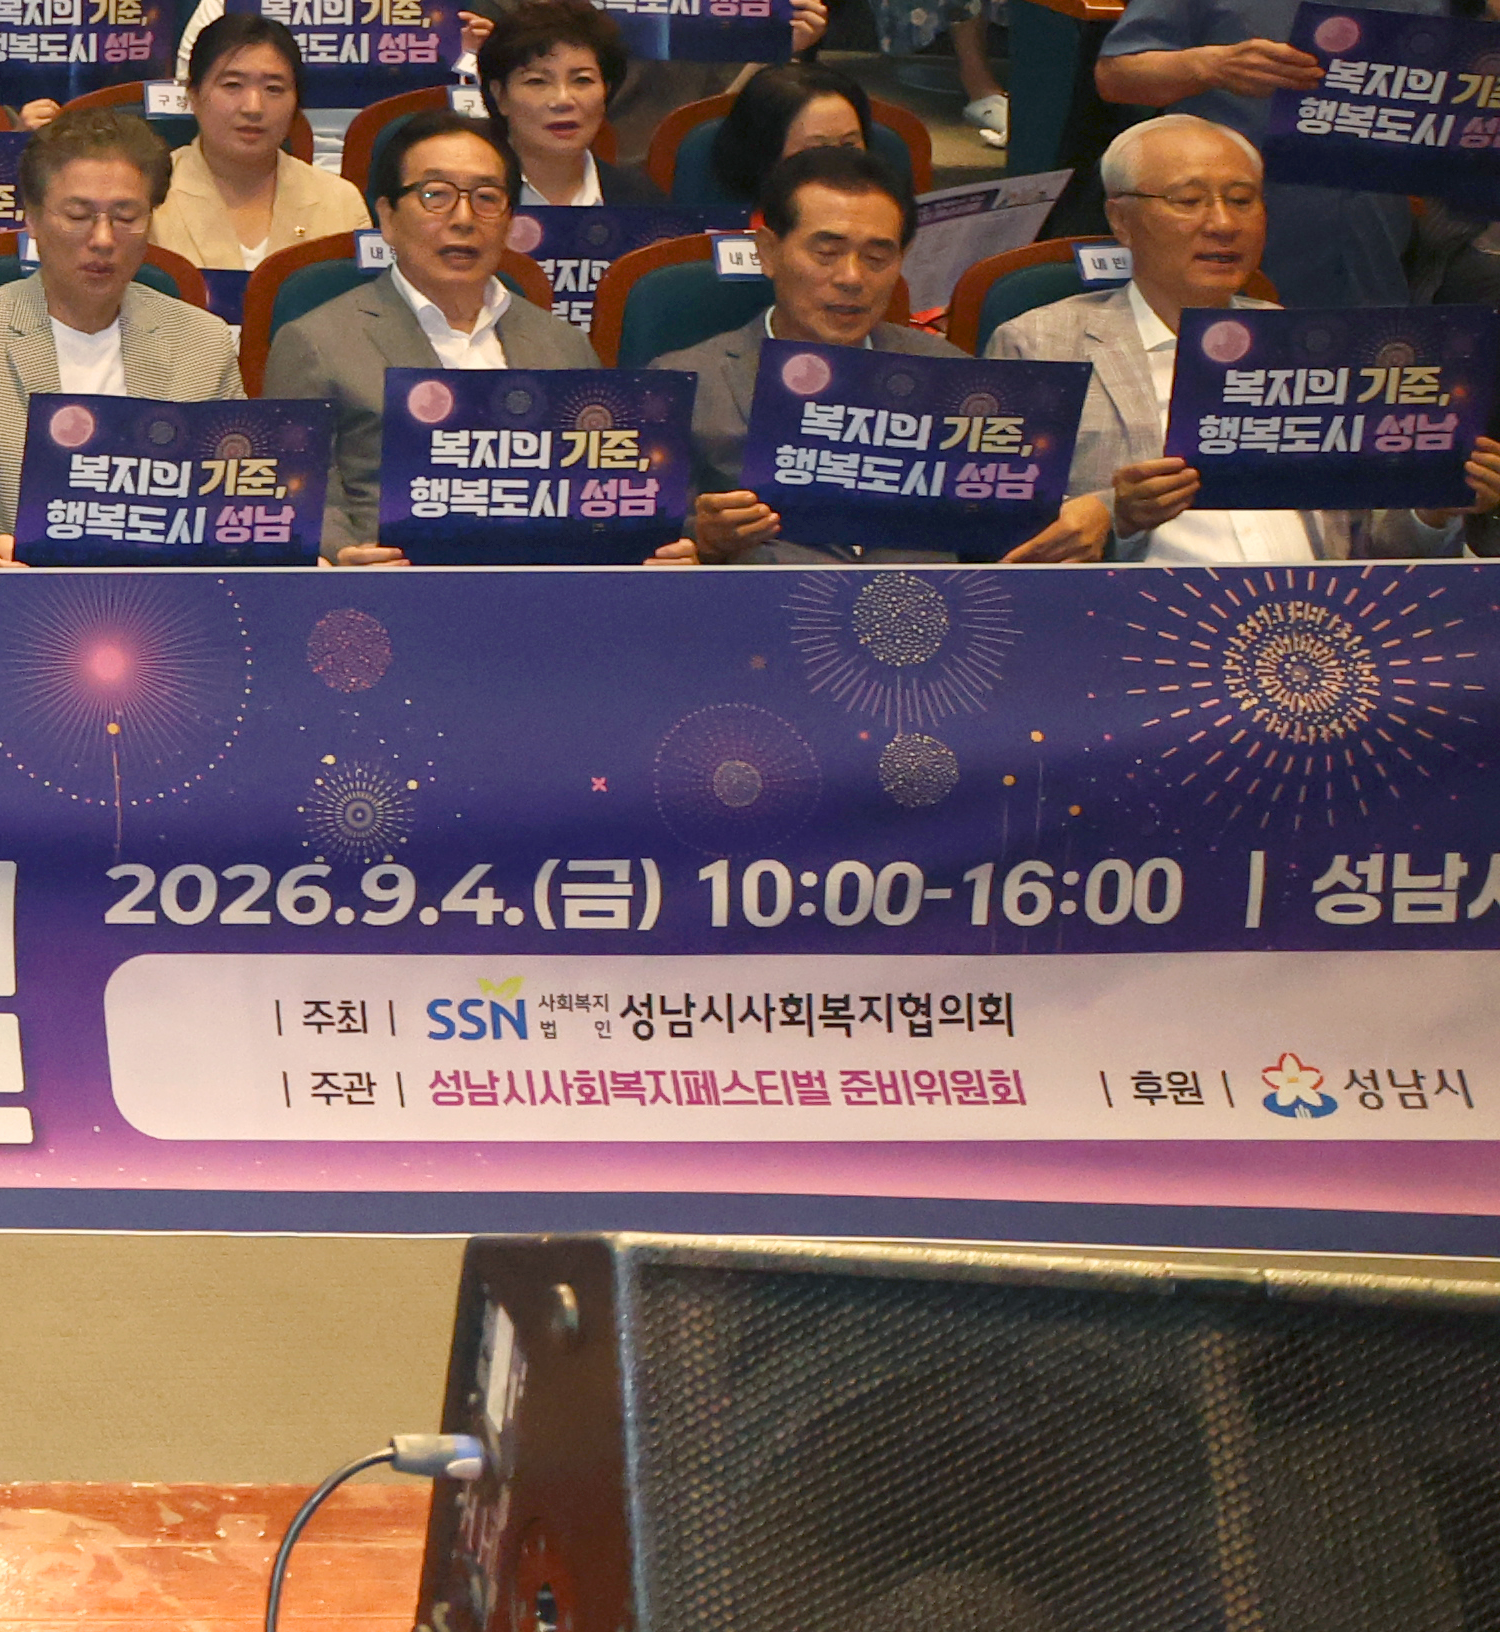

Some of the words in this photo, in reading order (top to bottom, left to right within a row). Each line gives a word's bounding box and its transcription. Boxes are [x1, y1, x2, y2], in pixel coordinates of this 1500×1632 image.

[1223, 368, 1348, 406] 복지의
[1357, 367, 1450, 406] 기준,
[801, 402, 932, 450] 복지의
[940, 417, 1032, 456] 기준,
[1199, 415, 1364, 454] 행복도시
[1375, 414, 1458, 452] 성남
[431, 430, 551, 469] 복지의
[561, 431, 649, 471] 기준,
[69, 454, 191, 497] 복지의
[199, 459, 286, 498] 기준,
[775, 445, 946, 496] 행복도시
[955, 463, 1039, 499] 성남
[411, 477, 569, 517] 행복도시
[581, 479, 659, 517] 성남
[47, 500, 206, 543] 행복도시
[216, 506, 295, 542] 성남
[104, 857, 662, 933] 2026.9.4.(금)
[699, 857, 1181, 929] 10:00-16:00
[301, 998, 368, 1036] 주최
[427, 999, 528, 1041] SSN
[620, 991, 1017, 1043] 성남시사회복지협의회
[538, 992, 611, 1014] 사회복지
[310, 1071, 377, 1108] 주관
[428, 1069, 831, 1109] 성남시사회복지페스티벌
[840, 1069, 1027, 1108] 준비위원회
[1130, 1070, 1205, 1106] 후원
[1343, 1068, 1475, 1110] 성남시
